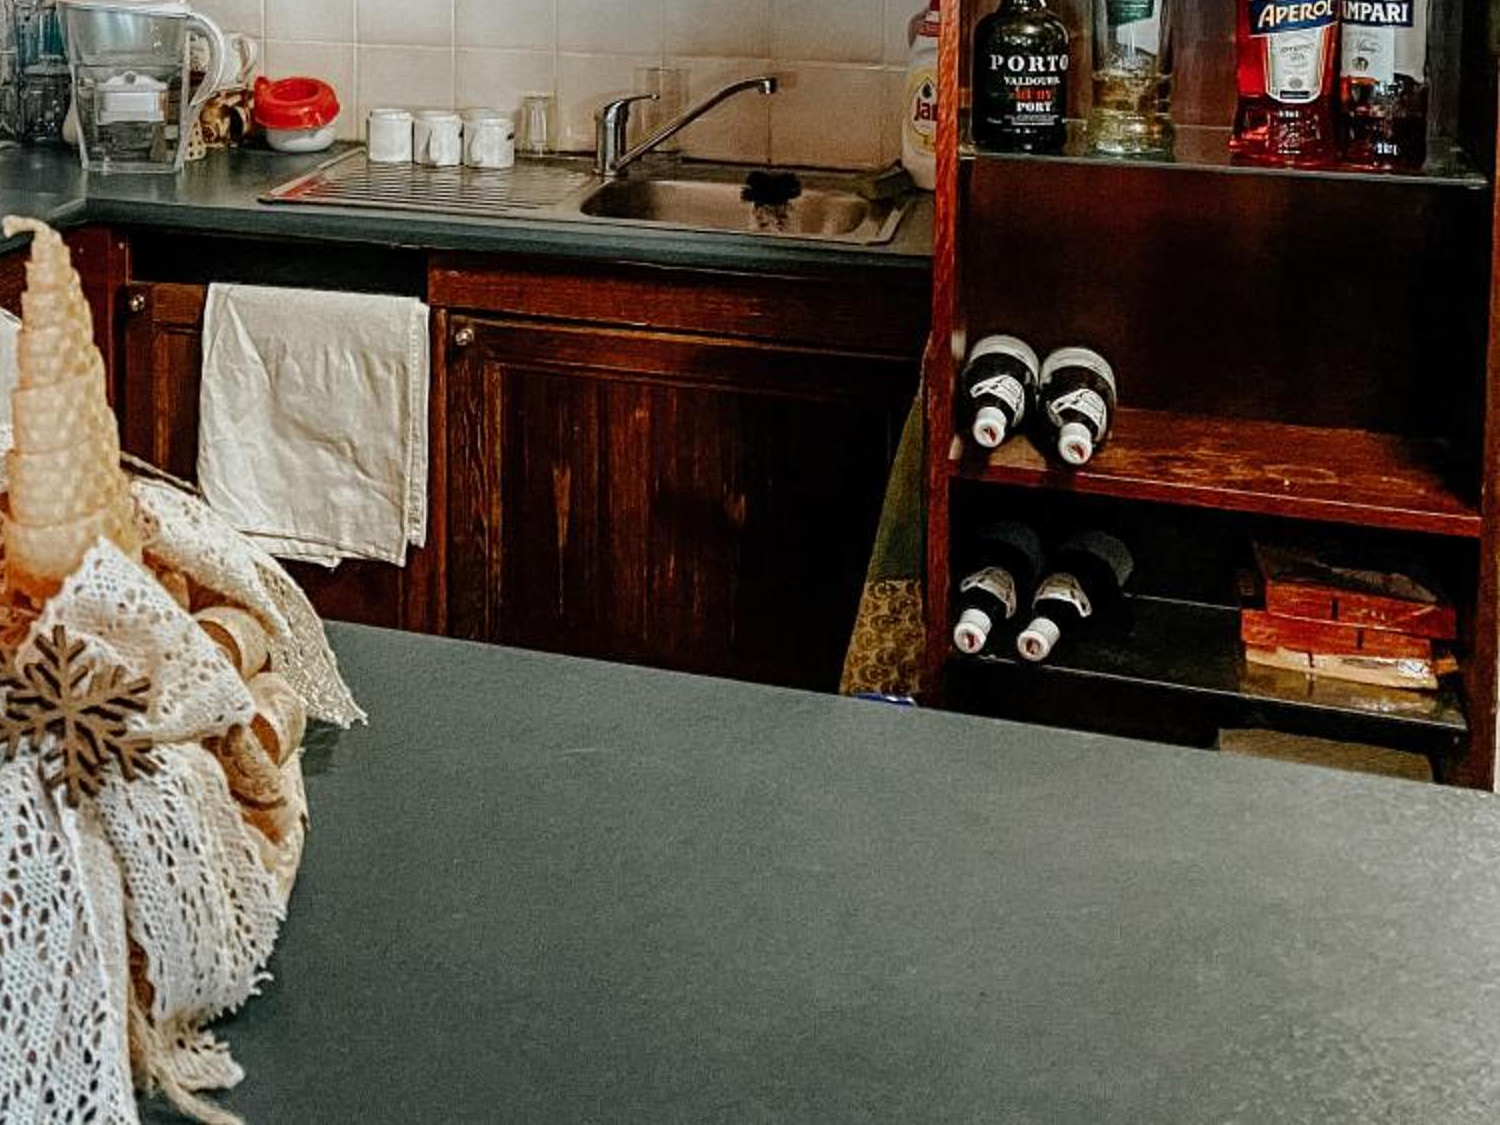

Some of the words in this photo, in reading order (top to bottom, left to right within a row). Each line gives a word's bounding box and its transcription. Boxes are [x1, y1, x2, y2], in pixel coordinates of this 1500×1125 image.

[1258, 0, 1334, 28] APEROL
[1342, 1, 1408, 23] MPARI
[990, 54, 1069, 72] PORTO
[1016, 101, 1052, 112] PORT
